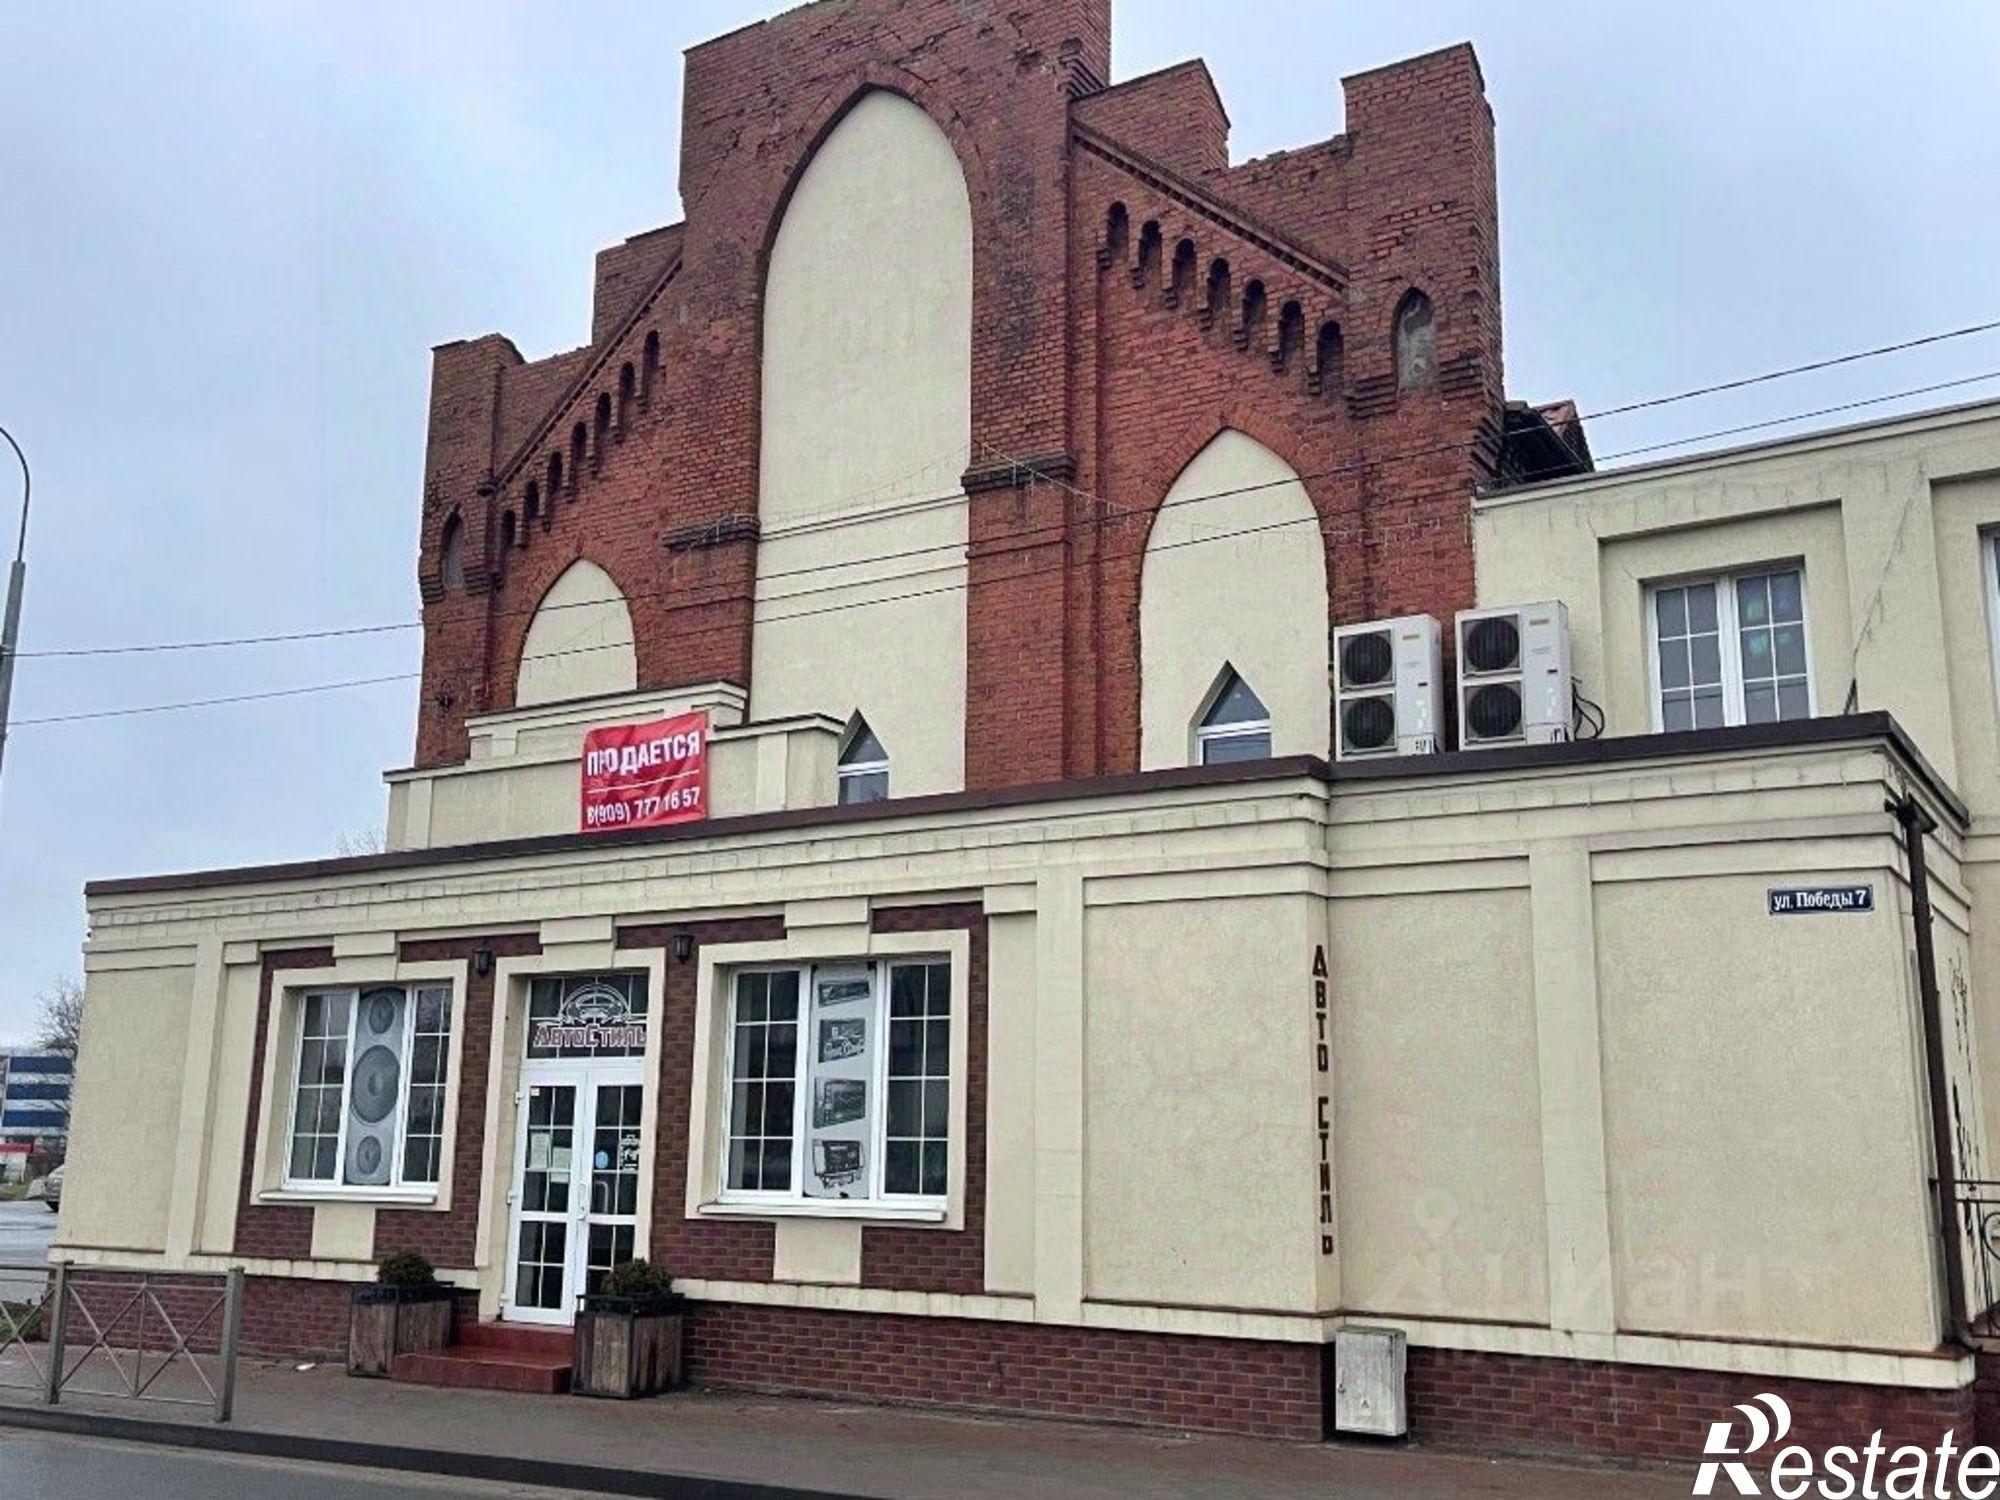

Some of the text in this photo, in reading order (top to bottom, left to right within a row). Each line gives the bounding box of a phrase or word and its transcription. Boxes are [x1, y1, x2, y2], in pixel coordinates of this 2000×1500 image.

[683, 786, 700, 808] 57
[1773, 889, 1867, 911] ул. Победы 7
[1311, 944, 1329, 1073] АВТО
